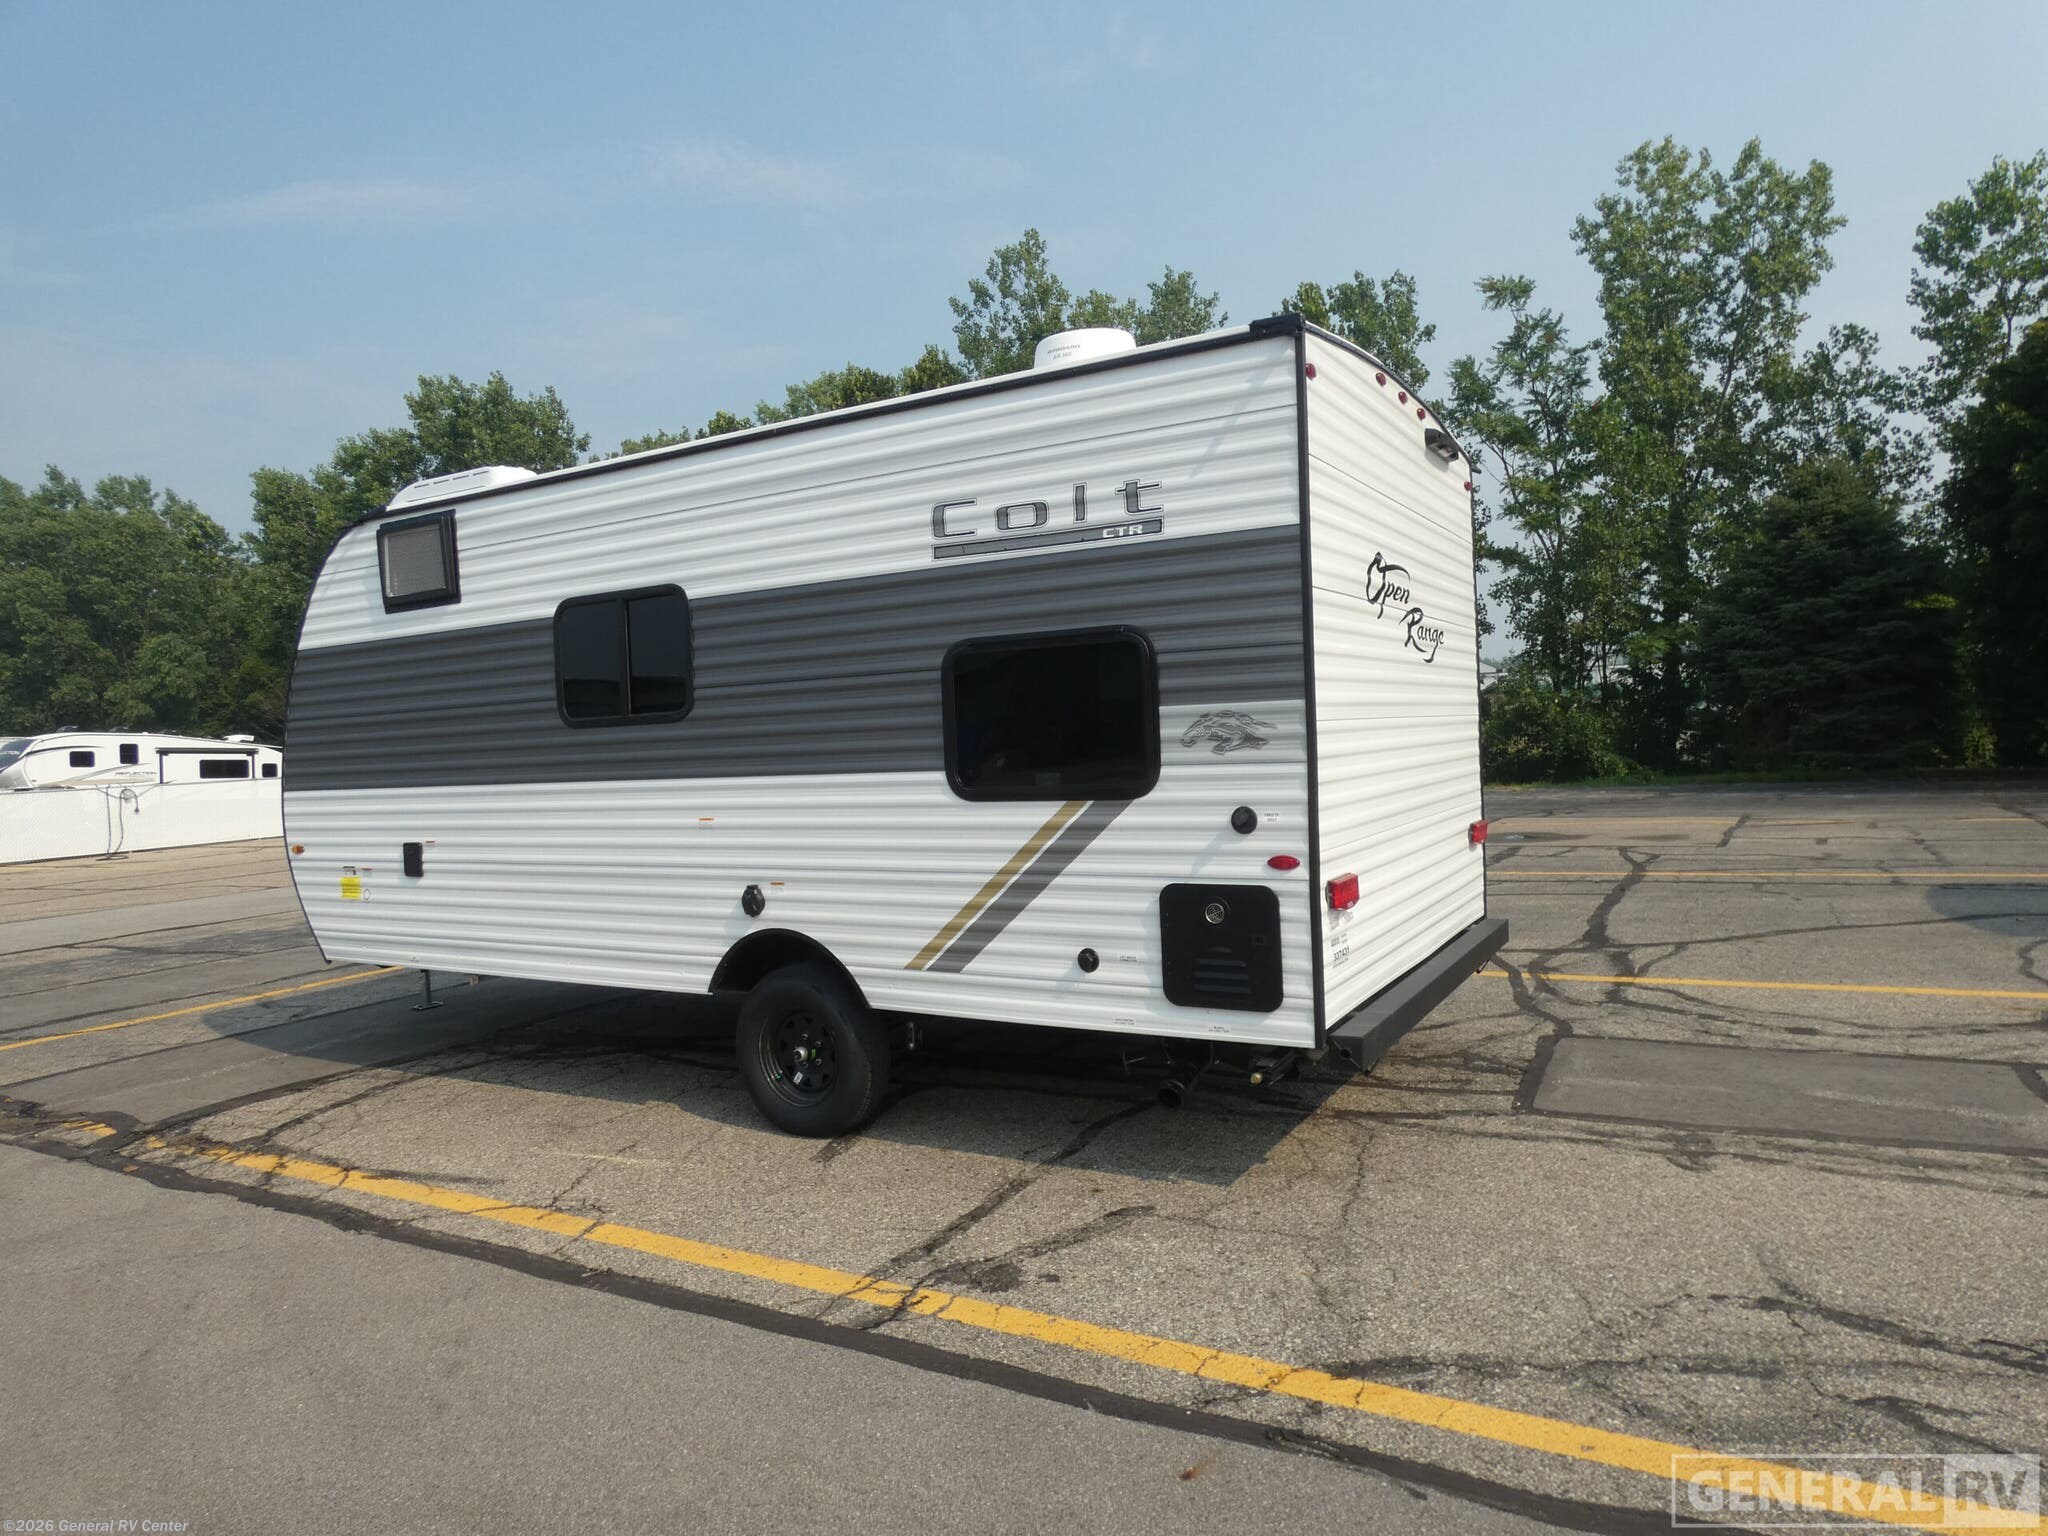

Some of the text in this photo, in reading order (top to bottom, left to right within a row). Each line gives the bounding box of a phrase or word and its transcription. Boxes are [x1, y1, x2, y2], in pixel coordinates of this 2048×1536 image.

[932, 480, 1163, 539] Colt
[1102, 524, 1143, 538] CTR
[1366, 551, 1410, 619] Open
[1399, 607, 1444, 663] Range
